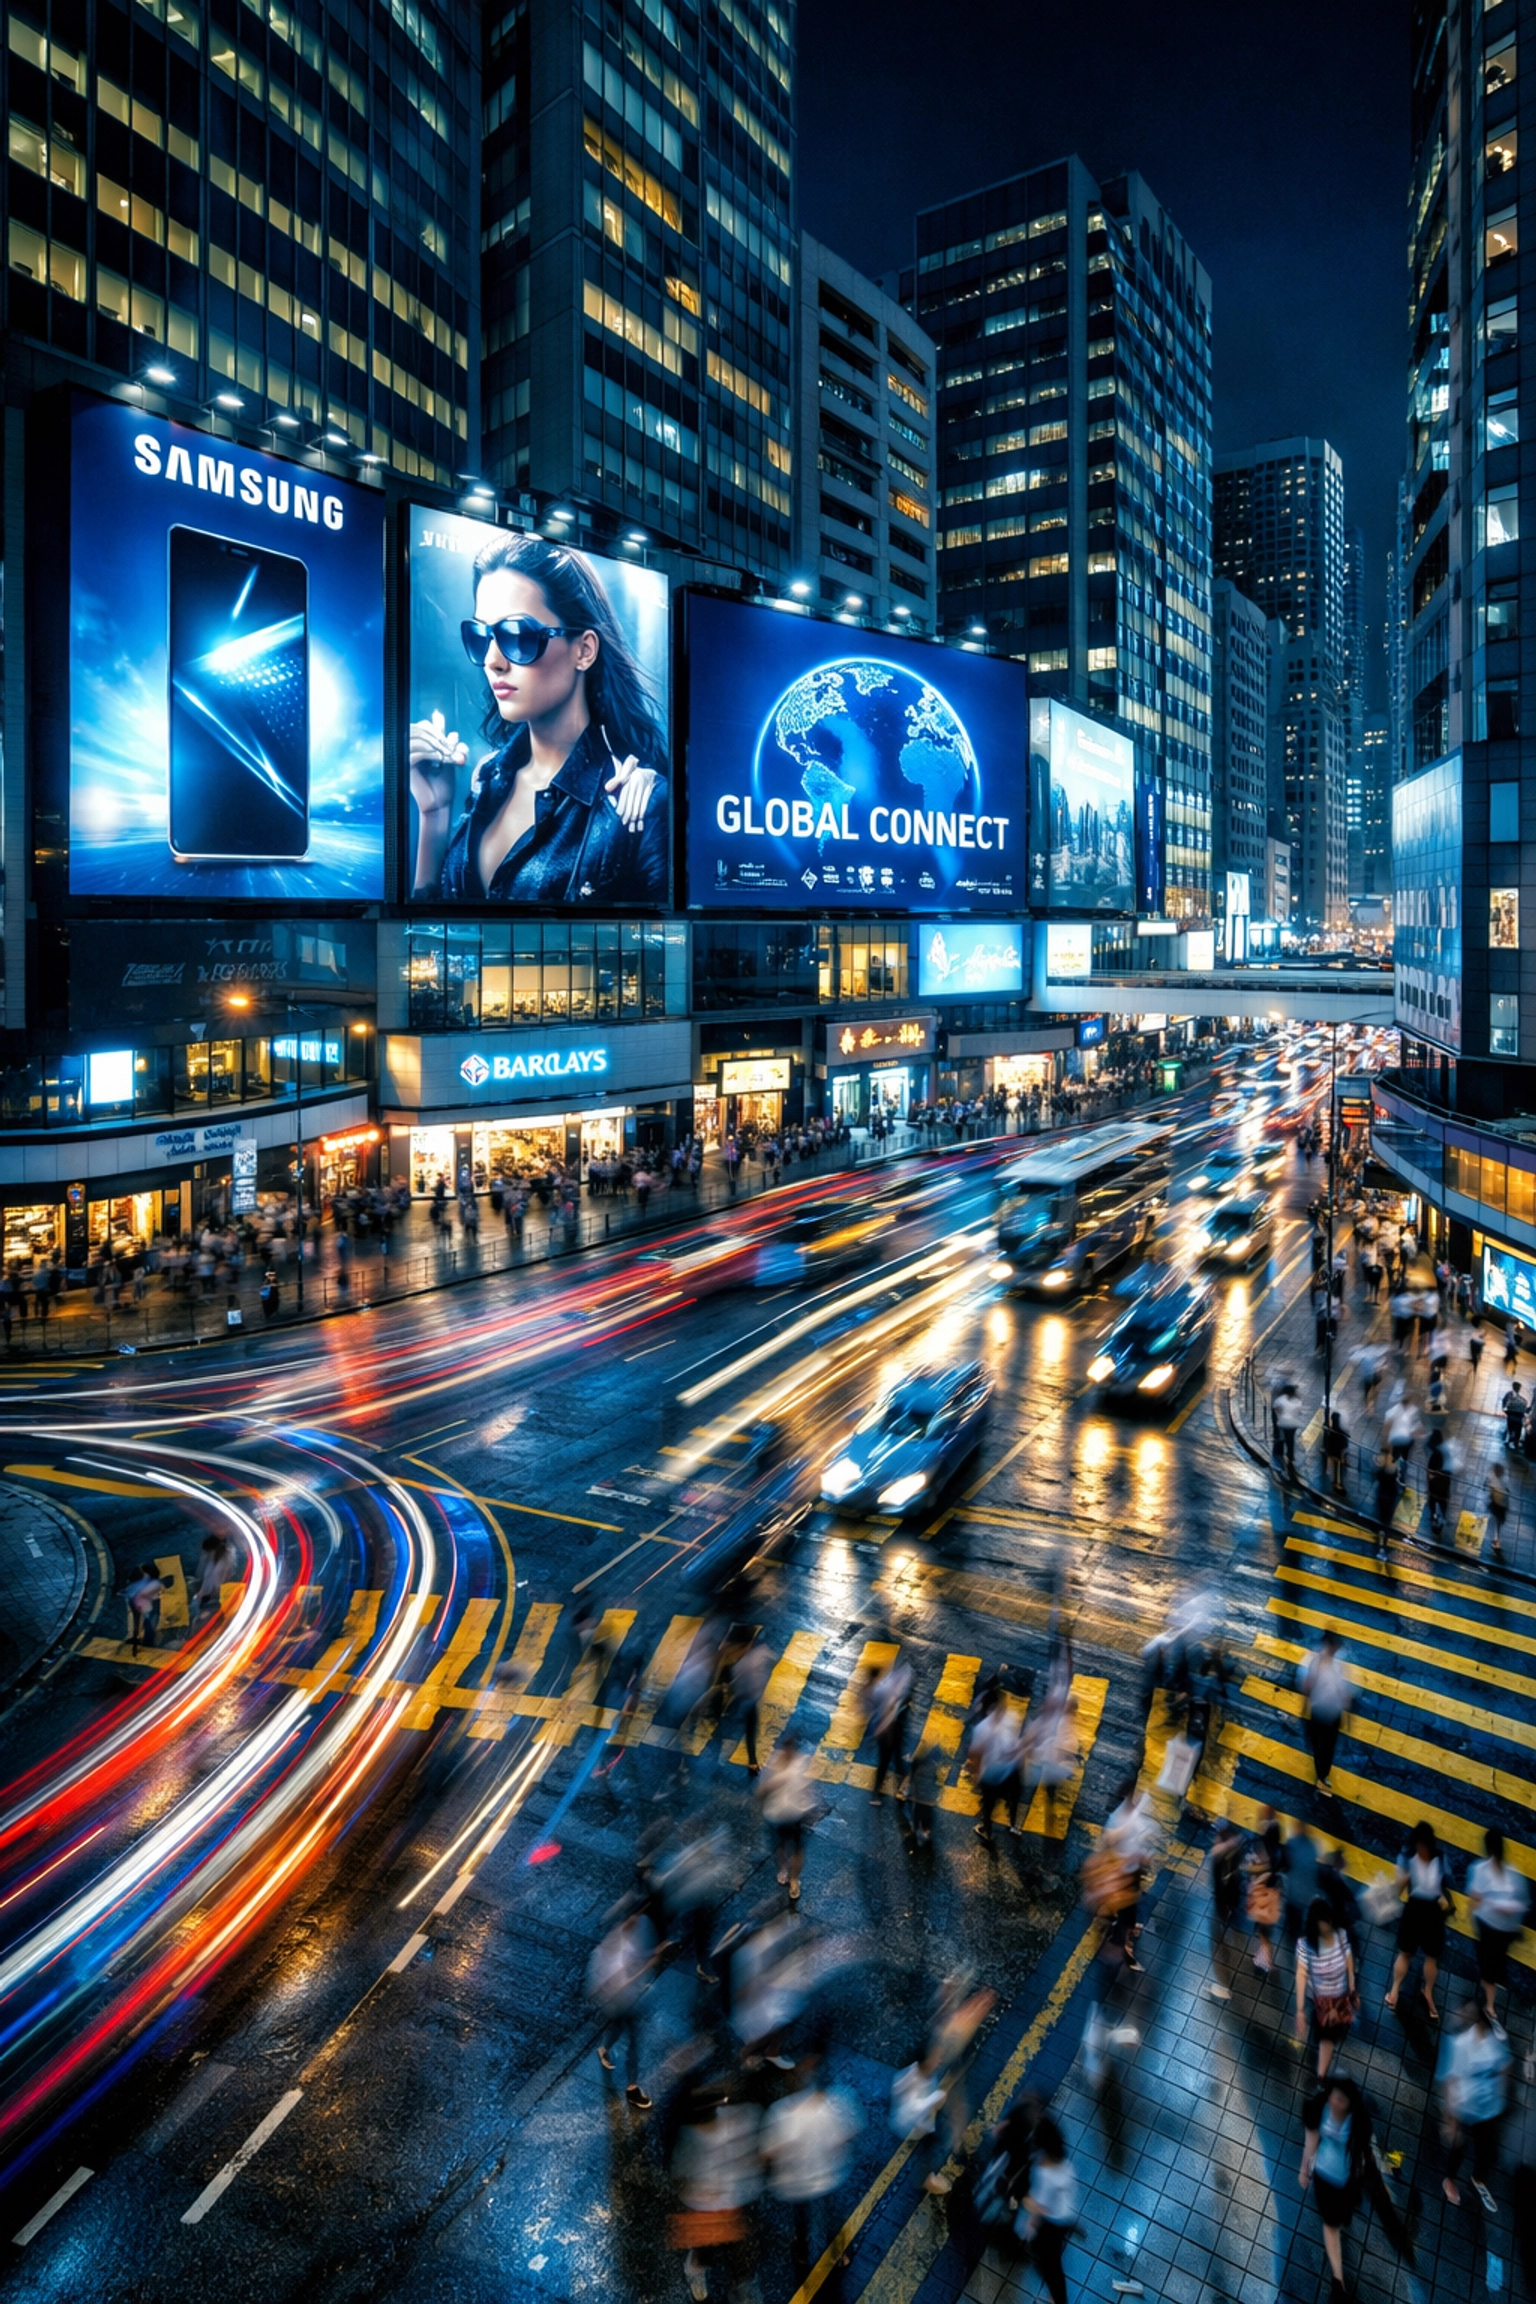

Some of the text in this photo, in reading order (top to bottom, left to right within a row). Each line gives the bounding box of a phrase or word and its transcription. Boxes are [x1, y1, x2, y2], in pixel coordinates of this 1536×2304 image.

[134, 433, 344, 531] SAMSUNG
[716, 794, 1010, 851] GLOBAL CONNECT
[493, 1049, 608, 1080] BARCLAYS
